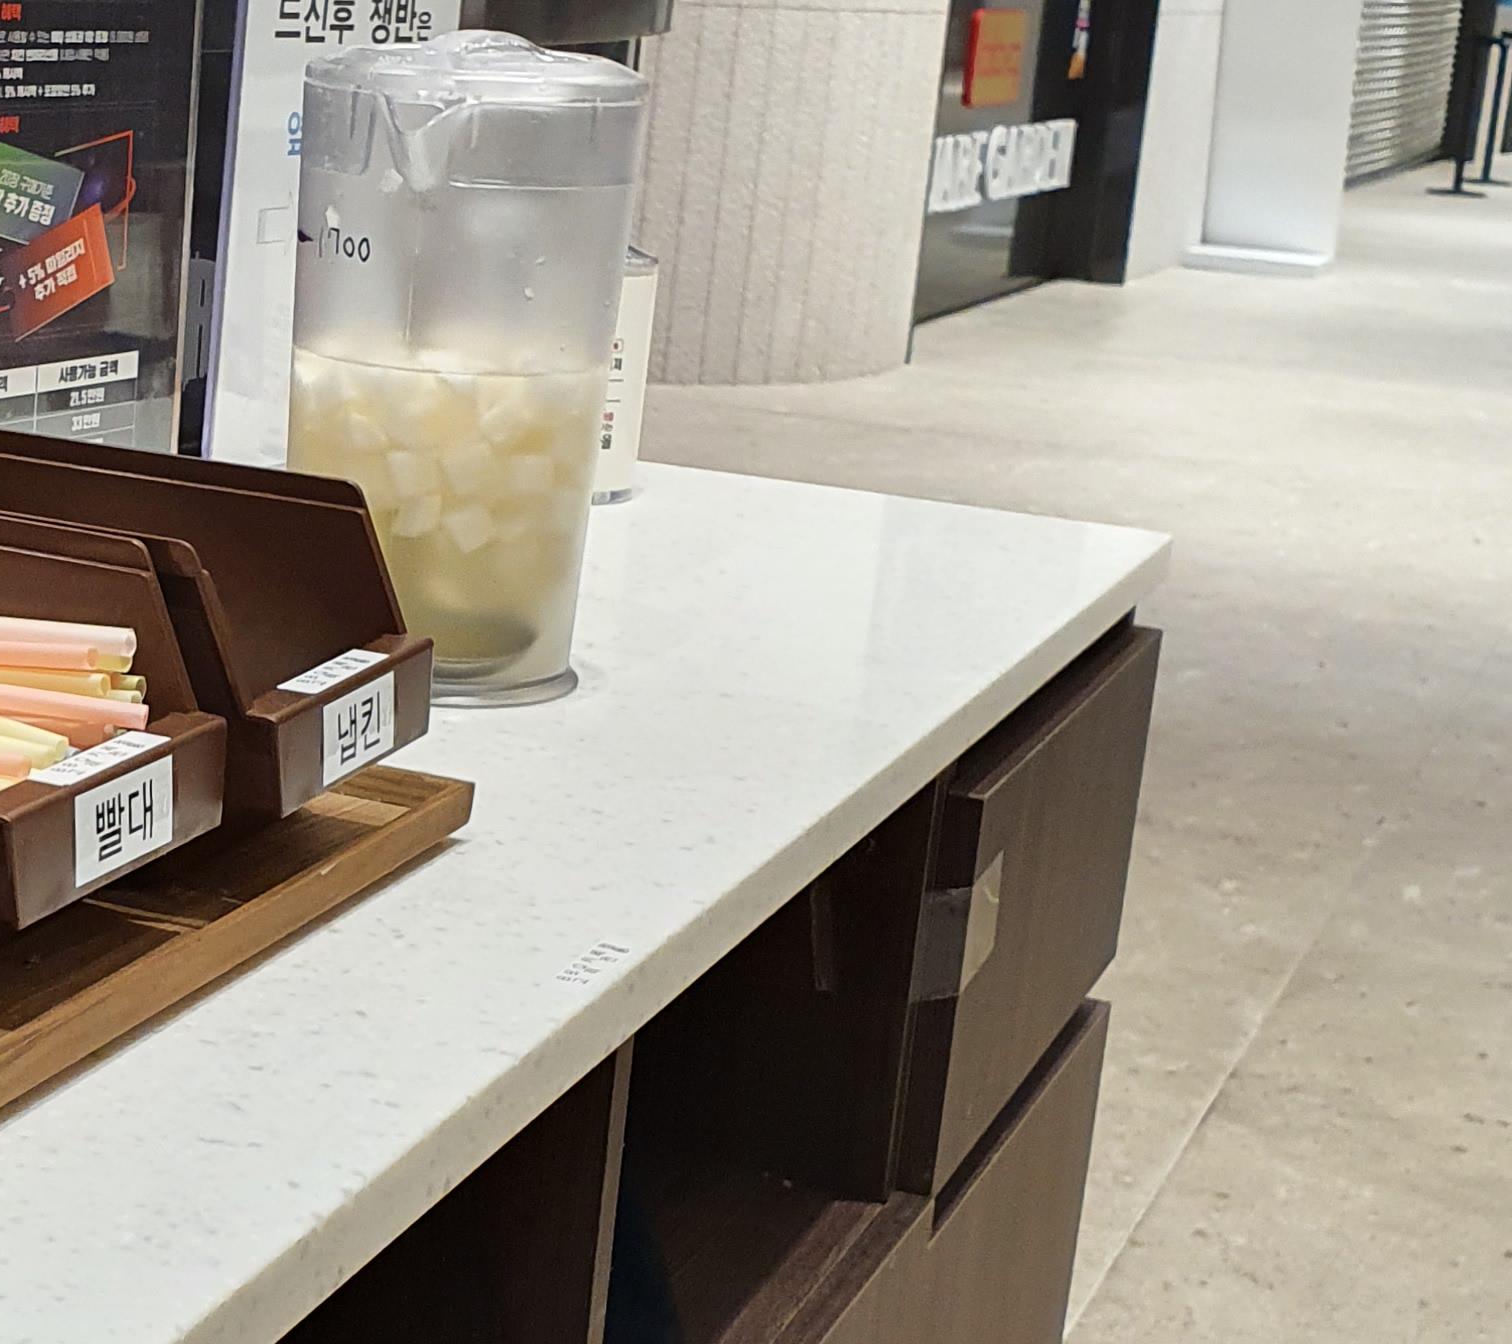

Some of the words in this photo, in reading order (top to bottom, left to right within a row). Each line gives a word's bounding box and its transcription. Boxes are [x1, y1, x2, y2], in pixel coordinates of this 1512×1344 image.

[3, 192, 31, 218] 추가
[336, 689, 382, 765] 냅킨
[95, 778, 154, 862] 빨대
